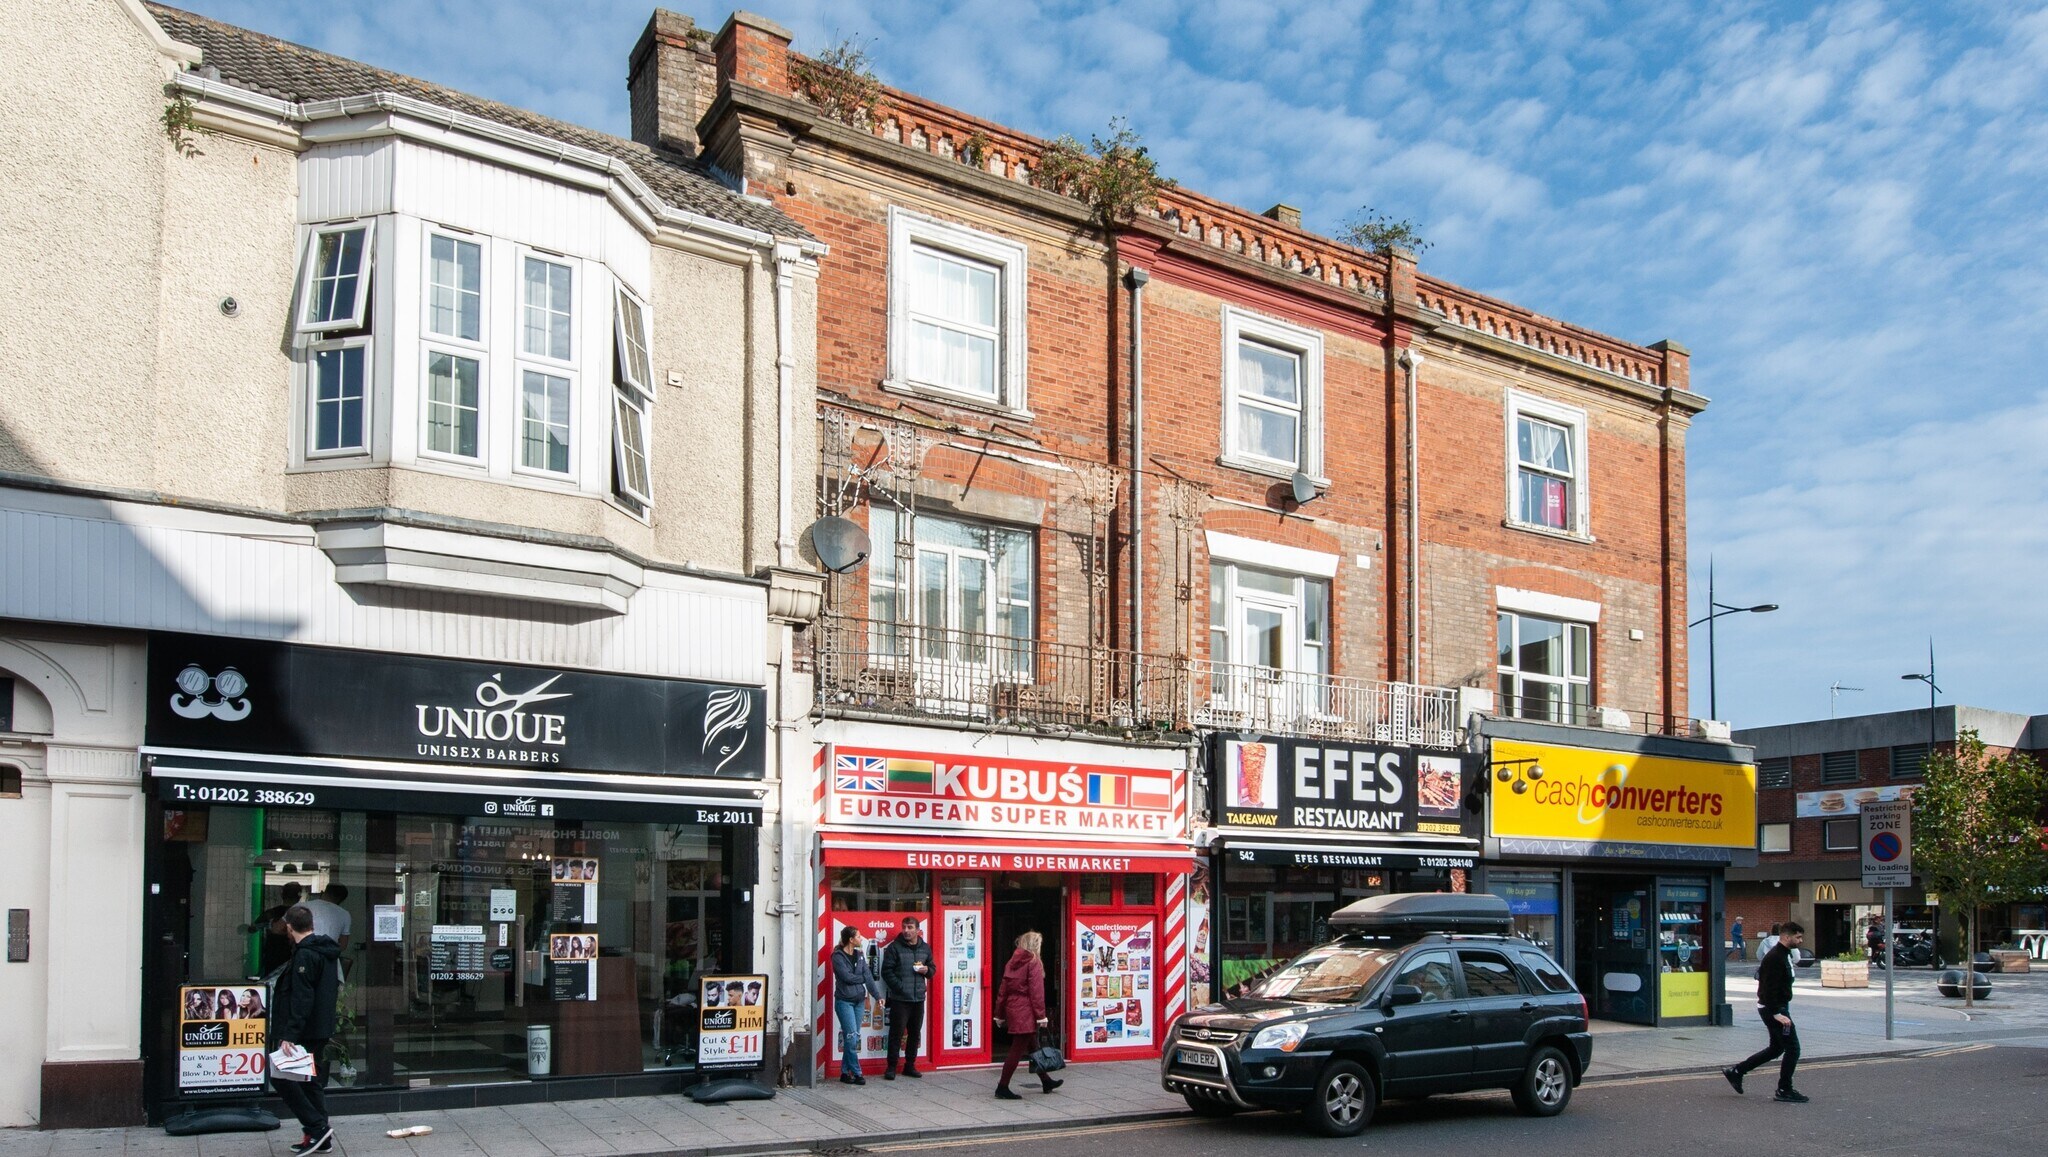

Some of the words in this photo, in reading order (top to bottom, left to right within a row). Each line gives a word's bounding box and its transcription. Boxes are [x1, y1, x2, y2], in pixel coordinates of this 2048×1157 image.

[417, 704, 566, 746] UNIQUE
[417, 743, 481, 759] UNISEX
[486, 747, 561, 763] BARBERS
[1294, 746, 1403, 805] EFES
[935, 763, 1085, 805] KUBUŚ
[254, 789, 315, 805] 388629
[503, 803, 536, 812] UNIQUE
[1864, 804, 1907, 813] Restricted
[696, 809, 720, 823] Est
[722, 811, 755, 825] 2011
[840, 797, 979, 822] EUROPEAN
[990, 806, 1067, 826] SUPER
[1079, 812, 1169, 831] MARKET
[1226, 812, 1278, 826] TAKEAWAY
[1293, 807, 1404, 831] RESTAURANT
[1869, 813, 1901, 821] parking
[1418, 823, 1436, 832] 01202
[1636, 814, 1724, 831] cashconverters.co.uk
[1870, 821, 1901, 830] ZONE
[1239, 850, 1255, 861] 542
[1294, 854, 1319, 864] EFES
[1322, 854, 1383, 866] RESTAURANT
[907, 853, 1001, 869] EUROPEAN
[1013, 856, 1132, 872] SUPERMARKET
[1418, 857, 1426, 867] T:
[1426, 857, 1447, 868] 01202
[1448, 858, 1473, 869] 394140
[1878, 863, 1909, 872] loading
[1505, 887, 1515, 895] We
[1514, 888, 1524, 896] buy
[1525, 887, 1537, 896] gold
[868, 920, 895, 929] drinks
[1091, 924, 1138, 932] confectionery
[430, 972, 454, 980] 01202
[455, 972, 484, 980] 388629
[245, 1022, 257, 1030] for
[739, 1017, 762, 1028] HIM
[963, 1021, 971, 1043] BLACK
[185, 1032, 223, 1041] UNIQUE
[232, 1032, 265, 1045] HER
[703, 1036, 717, 1044] Cut
[720, 1035, 728, 1044] &
[728, 1034, 759, 1054] £11
[704, 1046, 726, 1056] Style
[218, 1052, 266, 1076] £20
[1182, 1051, 1199, 1063] YH10
[1200, 1054, 1215, 1065] ERZ
[203, 1070, 217, 1078] Dry
